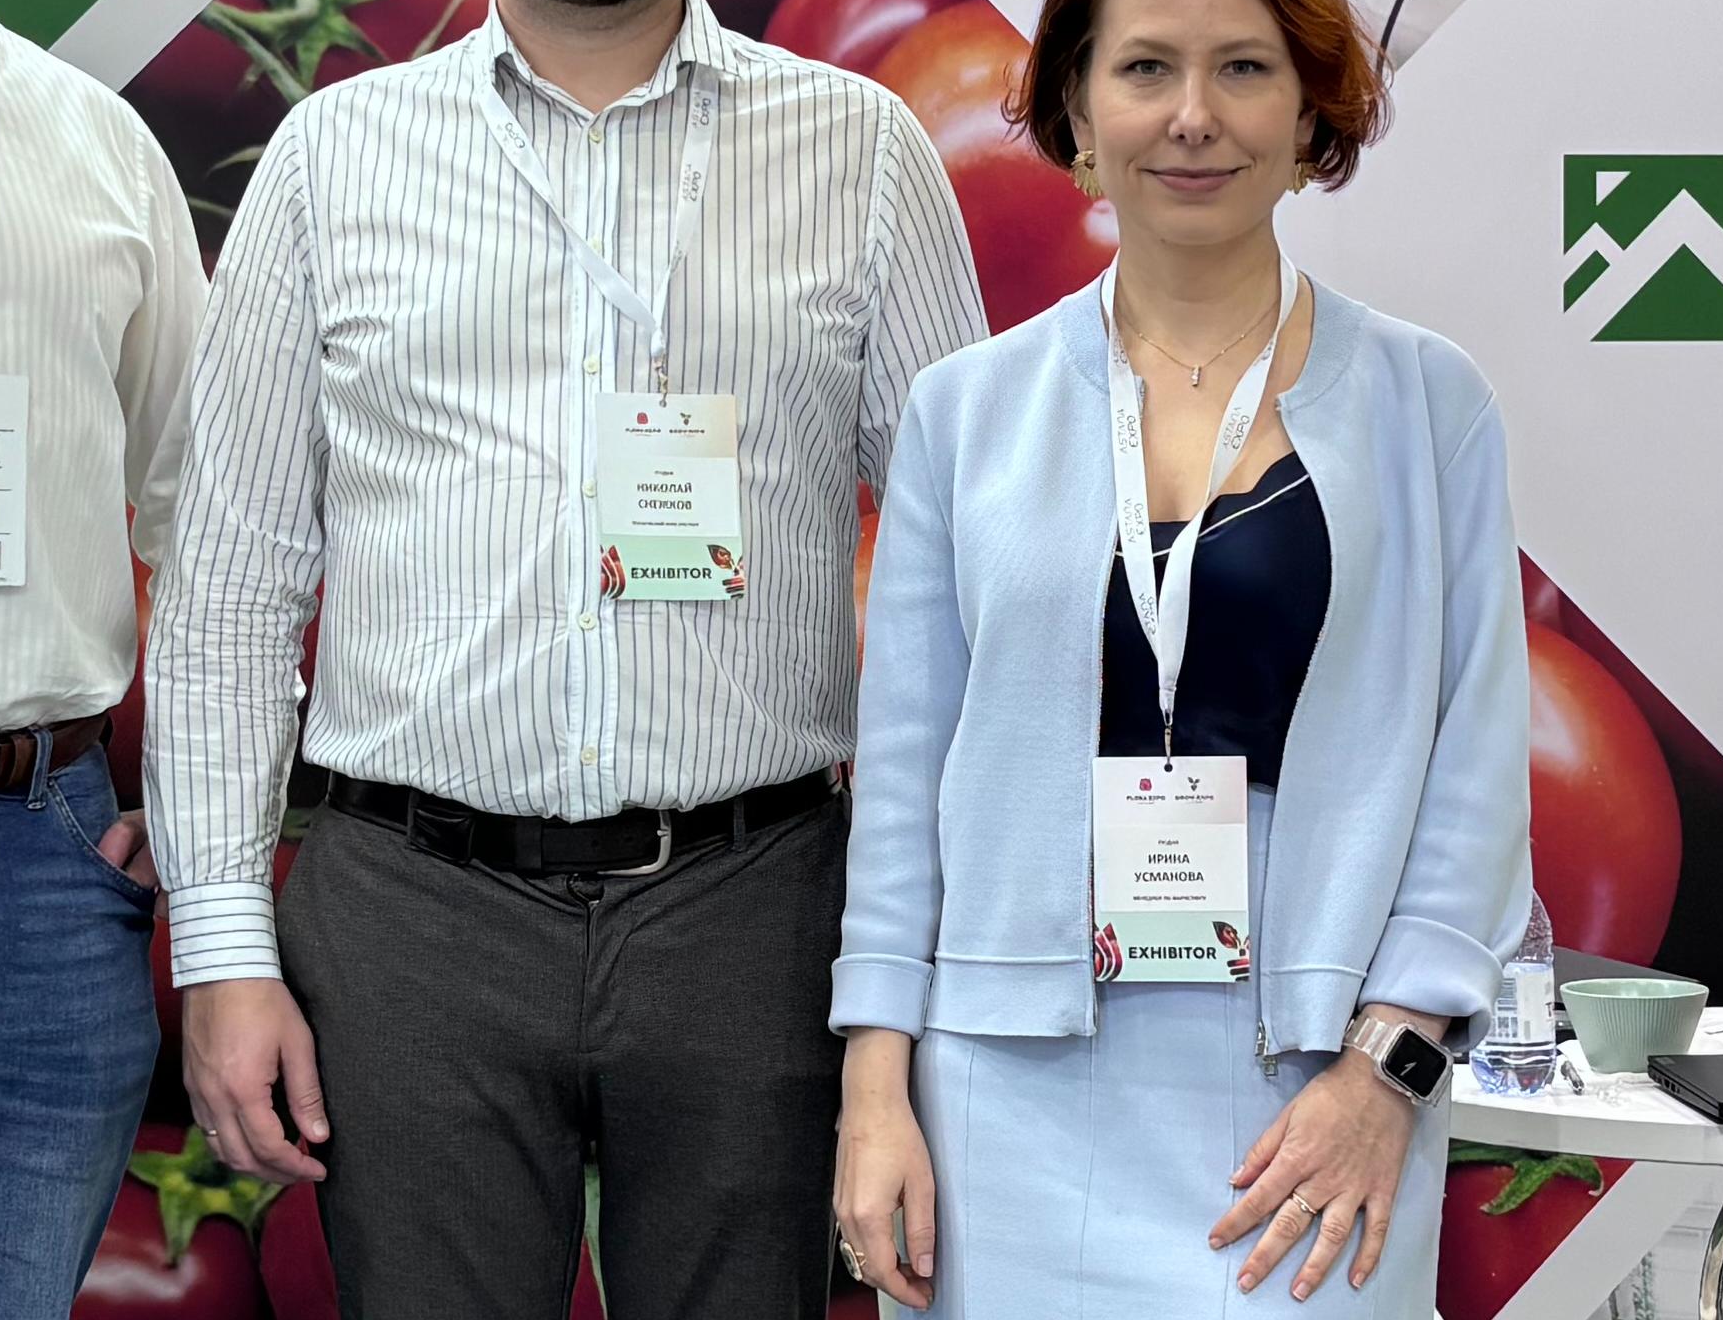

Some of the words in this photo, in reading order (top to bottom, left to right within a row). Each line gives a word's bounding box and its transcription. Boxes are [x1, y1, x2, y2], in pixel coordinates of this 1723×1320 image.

[1127, 415, 1139, 448] EXPO
[1231, 415, 1251, 450] EXPO
[631, 567, 712, 579] EXHIBITOR
[1148, 853, 1190, 864] ИРИНА
[1134, 871, 1205, 883] УСМАНОВА
[1128, 946, 1218, 960] EXHIBITOR
